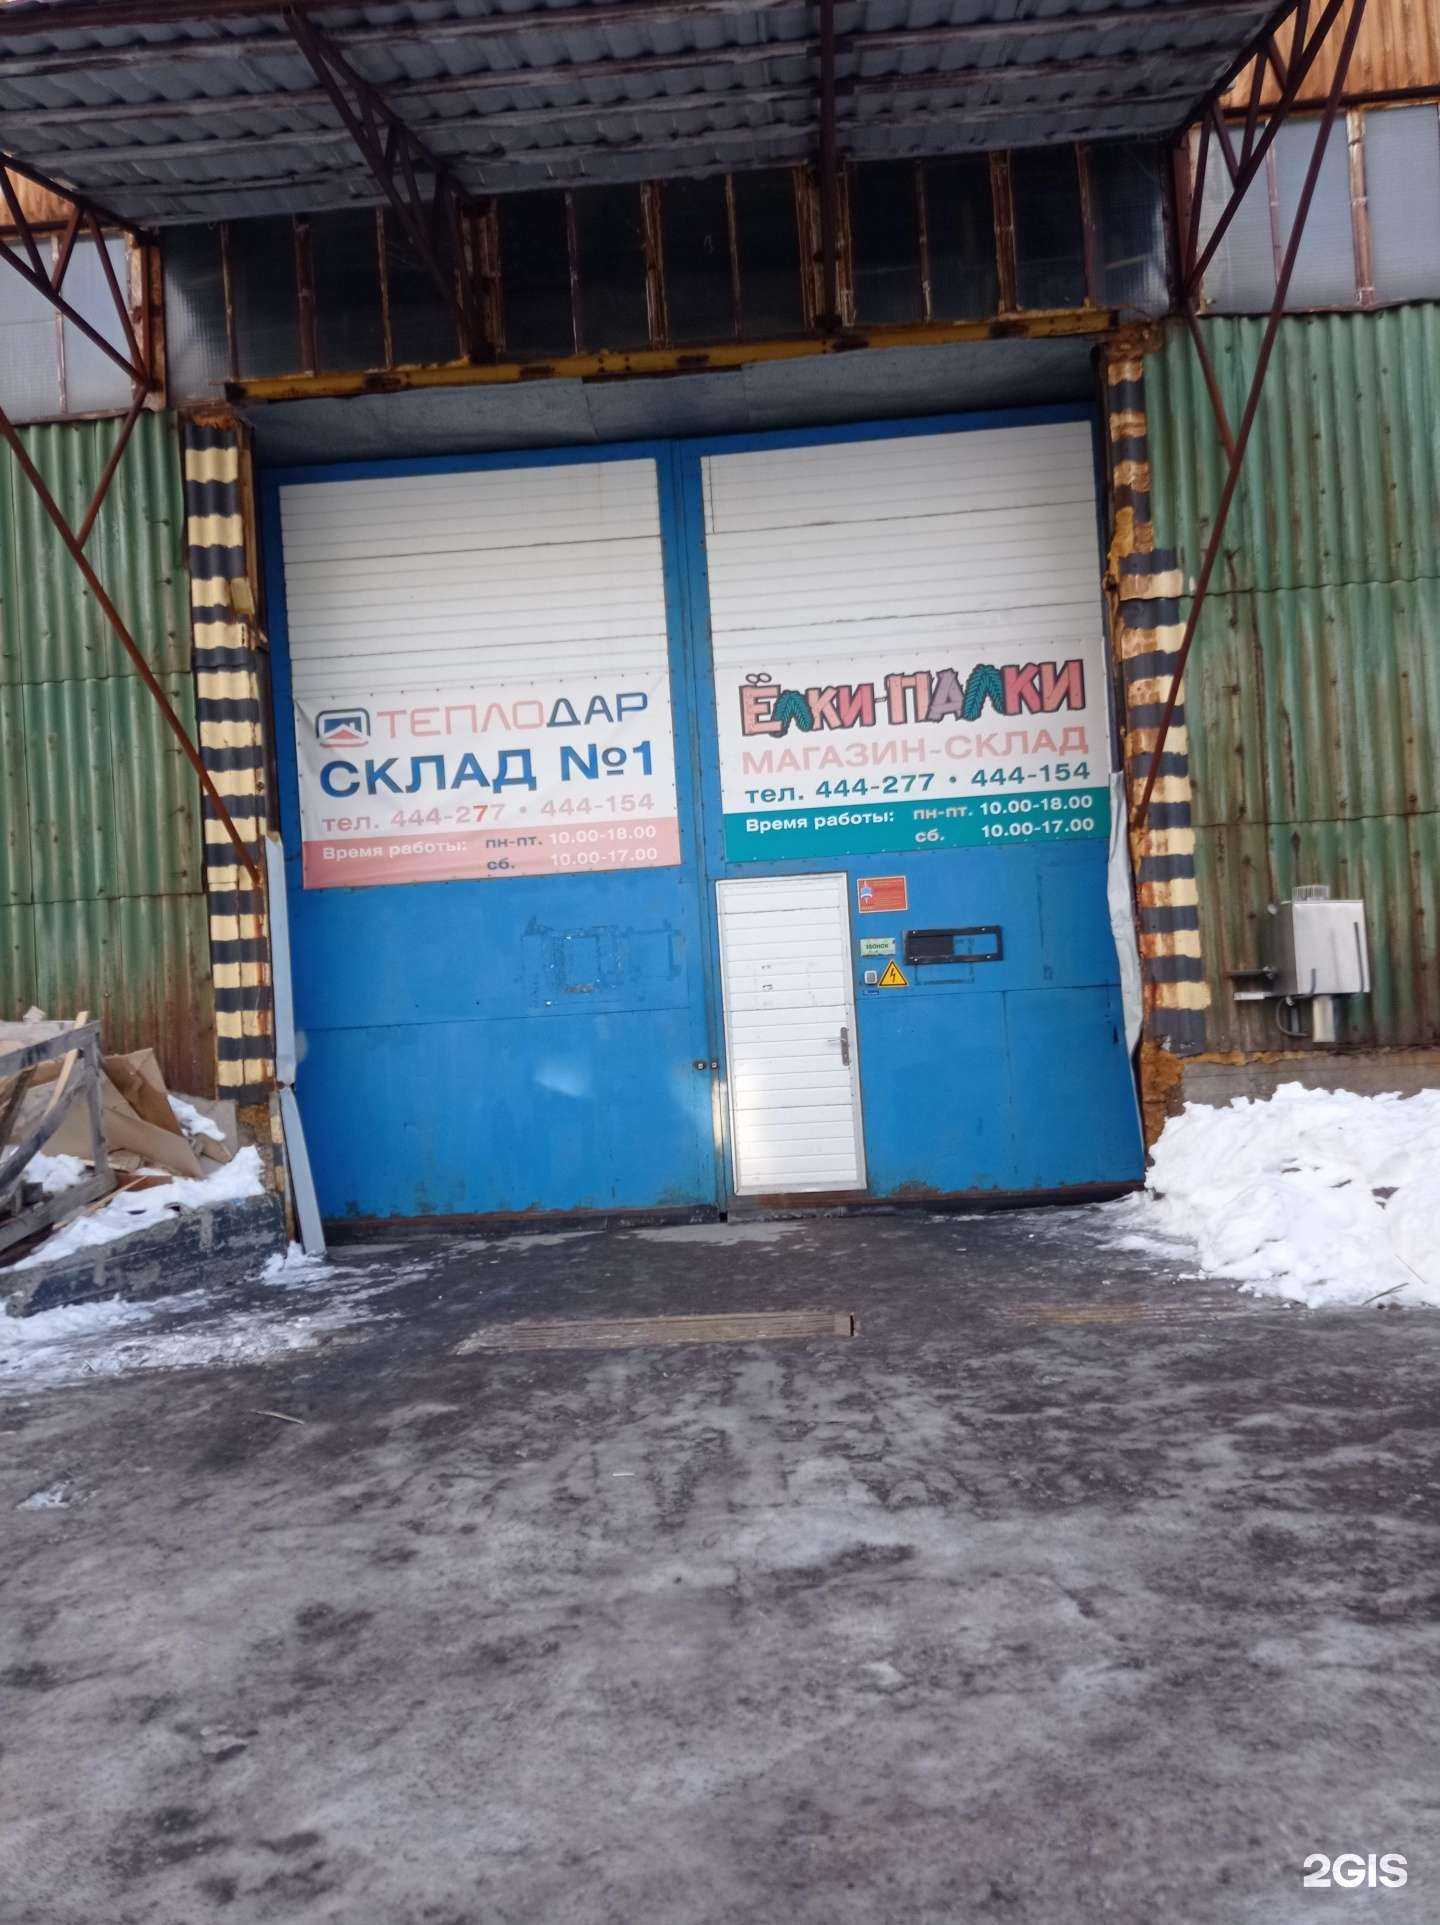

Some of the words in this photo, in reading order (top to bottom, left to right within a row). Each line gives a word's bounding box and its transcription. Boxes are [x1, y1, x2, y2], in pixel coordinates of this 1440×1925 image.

[377, 692, 648, 739] ТЕПЛОДАР
[739, 659, 1086, 738] ЁЛКИ-ПАЛКИ
[320, 747, 537, 798] СКЛАД
[559, 740, 653, 782] №1
[742, 726, 1089, 776] МАГАЗИН-СКЛАД
[744, 785, 804, 804] тел.
[815, 773, 936, 800] 444-277
[971, 761, 1091, 788] 444-154
[321, 814, 379, 833] тел.
[391, 803, 507, 829] 444-277
[541, 792, 656, 818] 444-154
[745, 817, 808, 833] Время
[813, 811, 896, 831] работы:
[913, 805, 974, 821] пн-пт.
[979, 794, 1094, 816] 10.00-18.00
[914, 827, 945, 843] сб.
[981, 817, 1095, 840] 10.00-17.00
[322, 844, 384, 862] Время
[389, 839, 467, 859] работы:
[485, 834, 543, 850] пн-пт.
[548, 824, 657, 846] 10.00-18.00
[486, 855, 516, 872] сб.
[551, 846, 658, 867] 10.00-17.00
